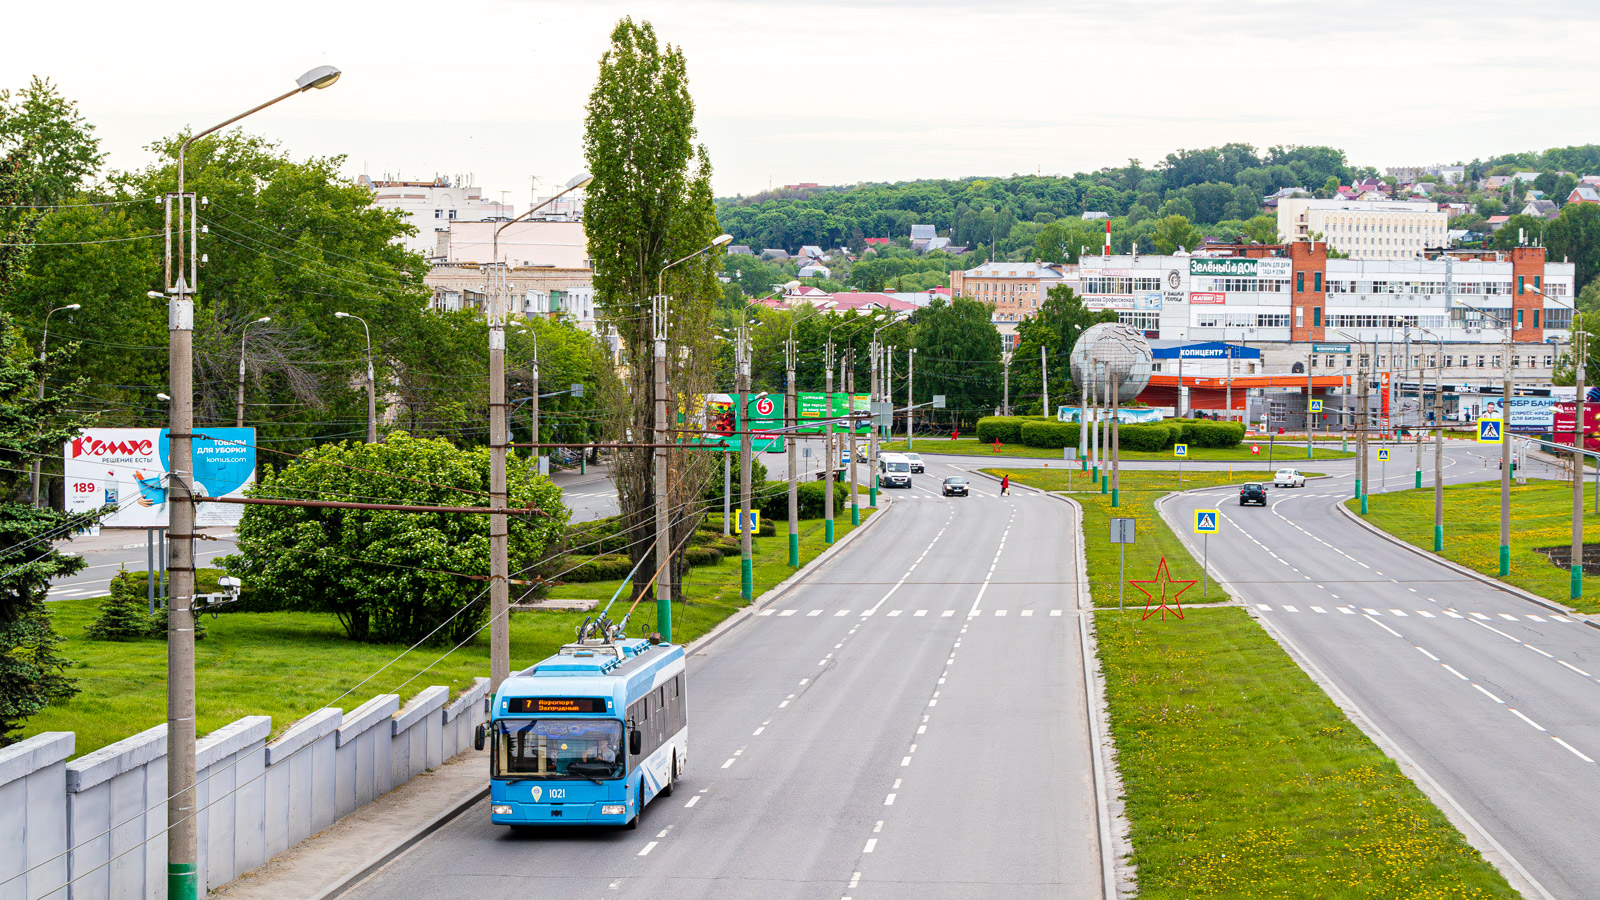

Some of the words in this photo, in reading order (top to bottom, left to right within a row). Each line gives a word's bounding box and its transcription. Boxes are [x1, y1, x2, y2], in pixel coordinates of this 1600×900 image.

[1190, 260, 1231, 273] Зелёный
[1180, 349, 1224, 357] КОПИЦЕНТР
[761, 399, 769, 412] 5
[1509, 399, 1530, 407] ББР
[72, 436, 153, 459] Комус
[213, 439, 247, 447] ТОВАРЫ
[73, 482, 95, 493] 189
[526, 699, 532, 708] 7
[549, 788, 566, 799] 1021
